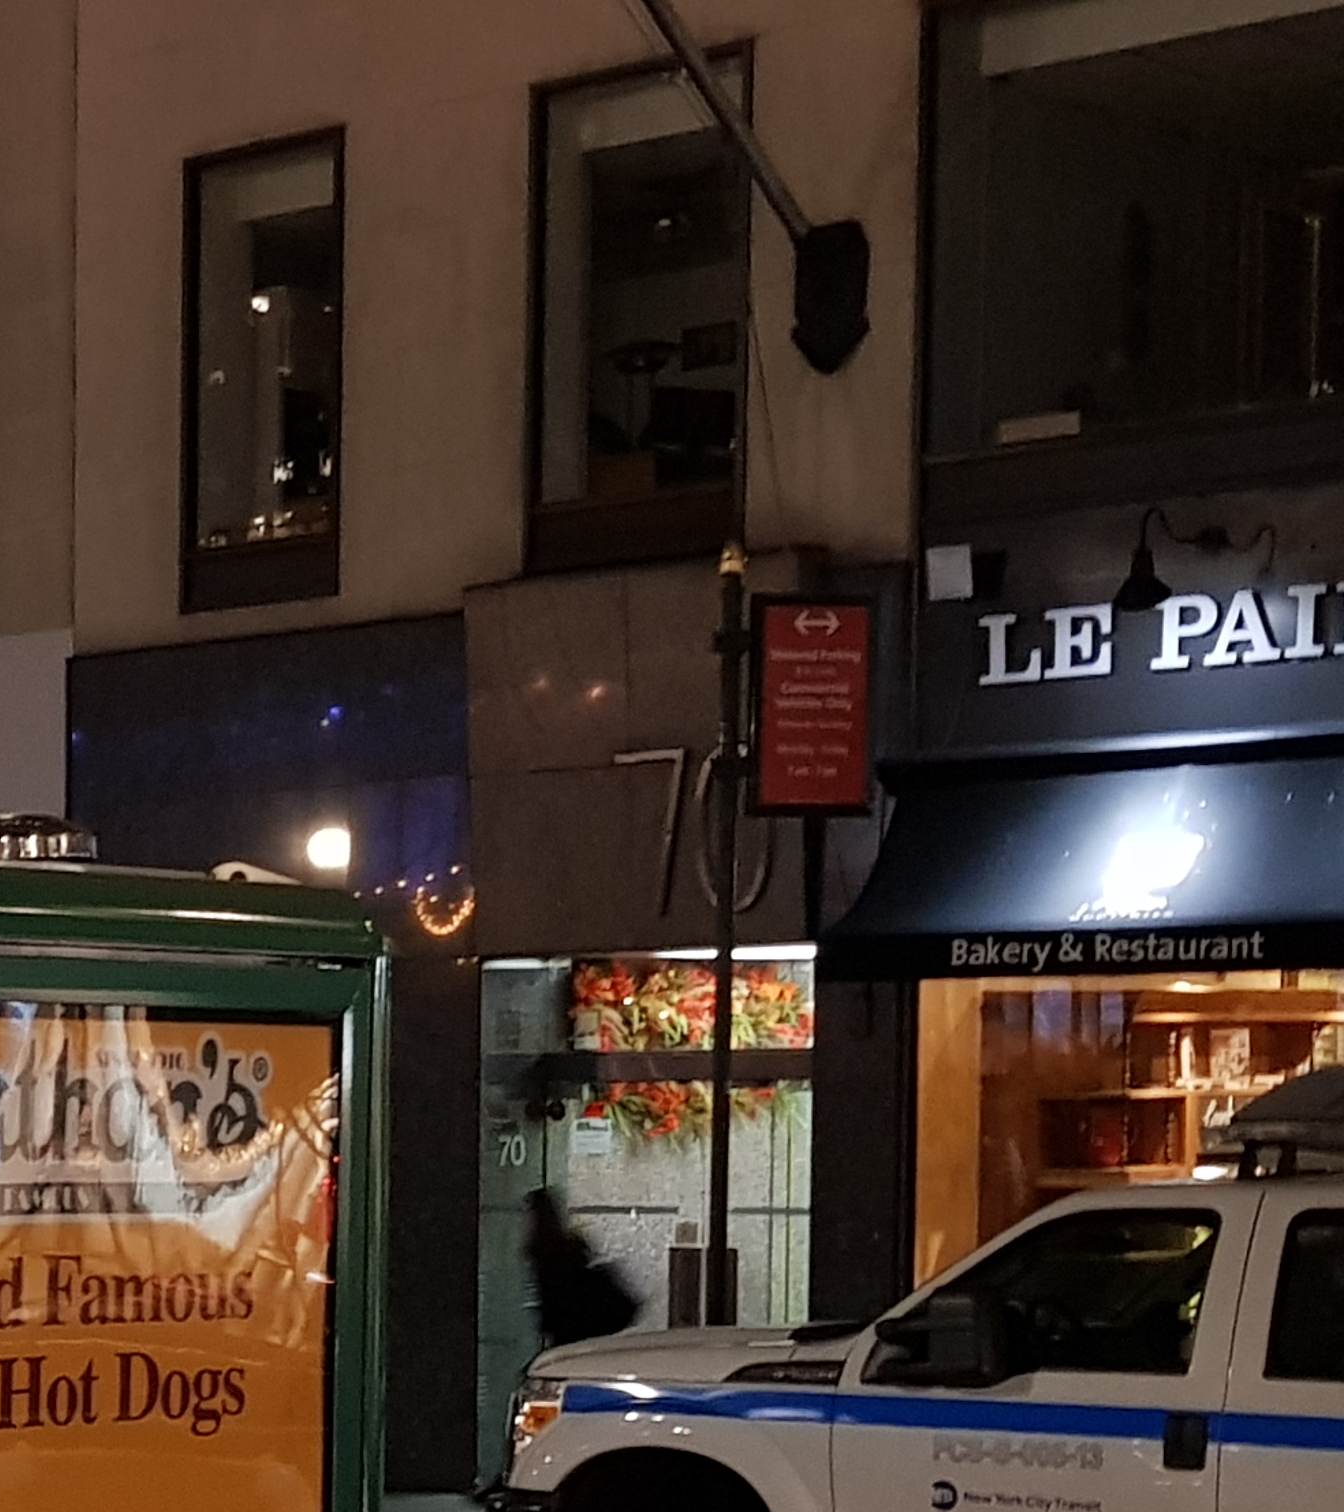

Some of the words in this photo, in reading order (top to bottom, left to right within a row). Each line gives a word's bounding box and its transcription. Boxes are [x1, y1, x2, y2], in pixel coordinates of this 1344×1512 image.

[977, 602, 1113, 688] LE
[950, 935, 1051, 972] Bakery
[1059, 932, 1083, 962] &
[1095, 930, 1265, 961] Restaurant
[498, 1134, 526, 1166] 70
[43, 1255, 253, 1326] Famous
[115, 1351, 245, 1436] Dogs
